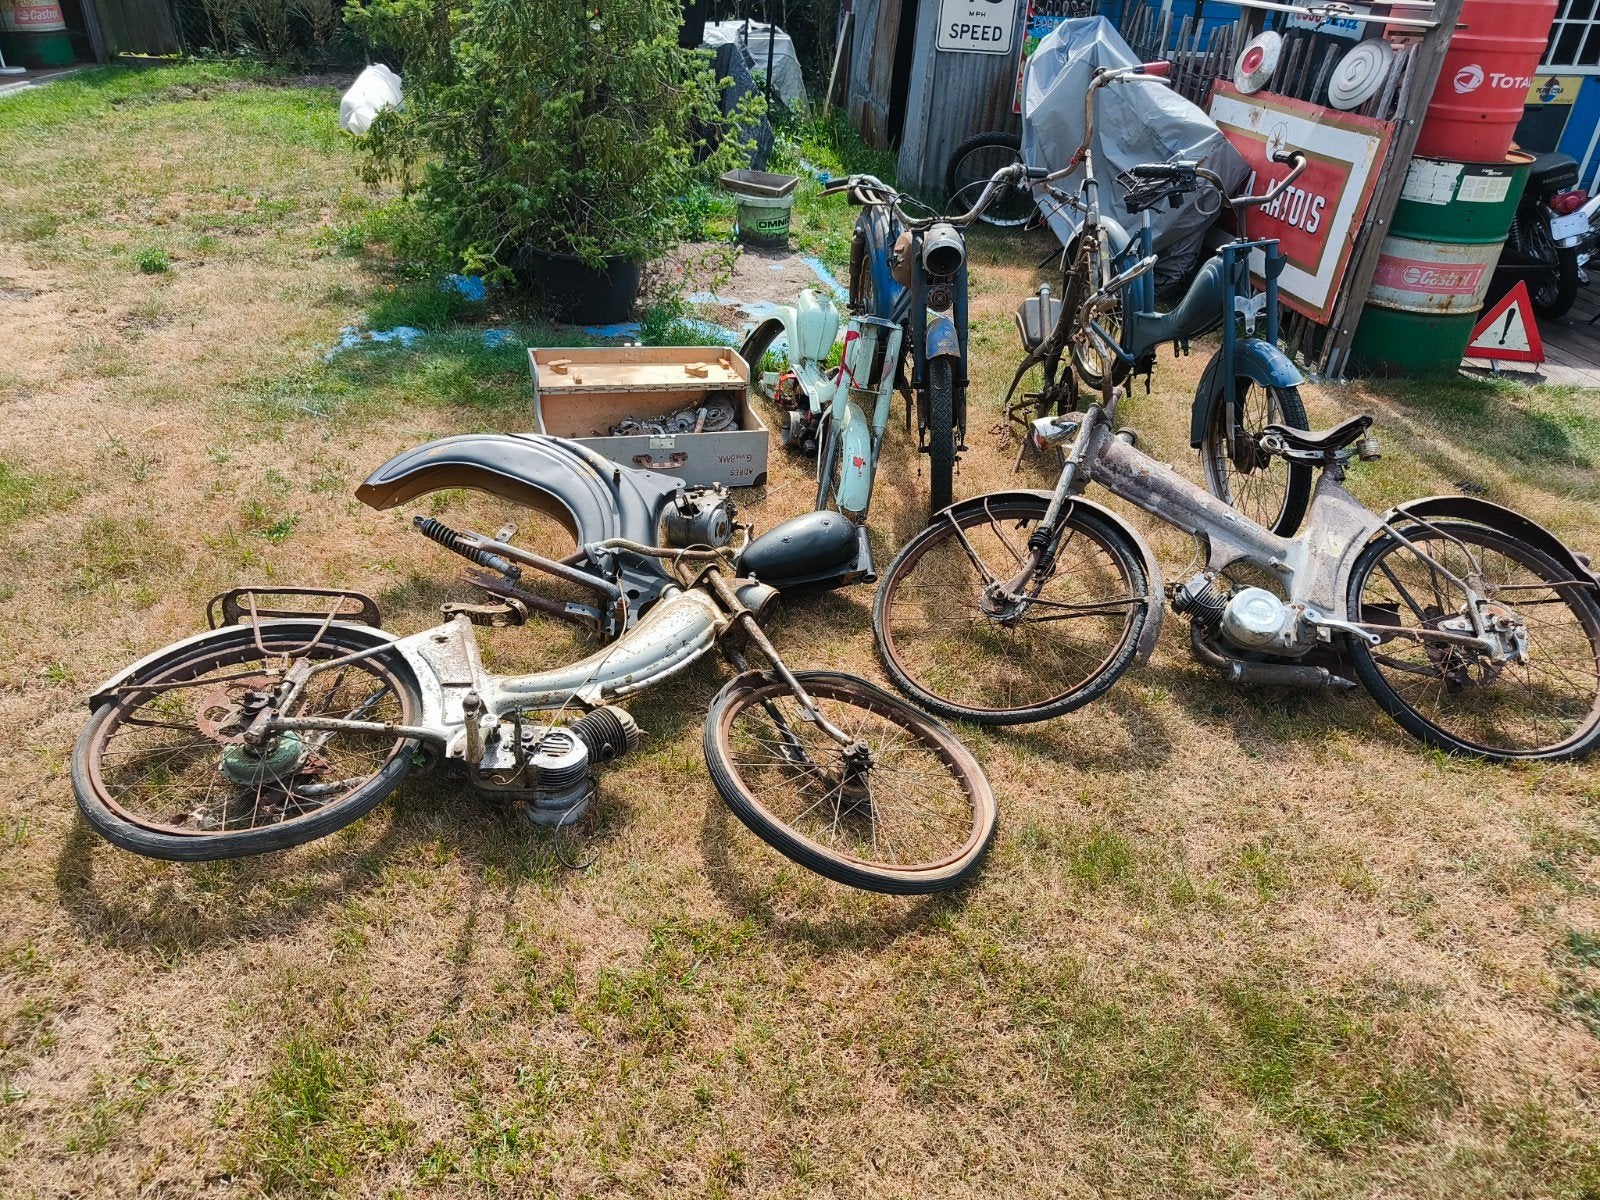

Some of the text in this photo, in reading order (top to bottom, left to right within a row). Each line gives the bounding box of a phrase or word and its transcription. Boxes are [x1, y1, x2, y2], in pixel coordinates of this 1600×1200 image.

[30, 8, 59, 20] Castrol
[948, 22, 1003, 42] SPEED
[1259, 177, 1326, 233] ARTOIS
[1419, 270, 1473, 287] Castrol
